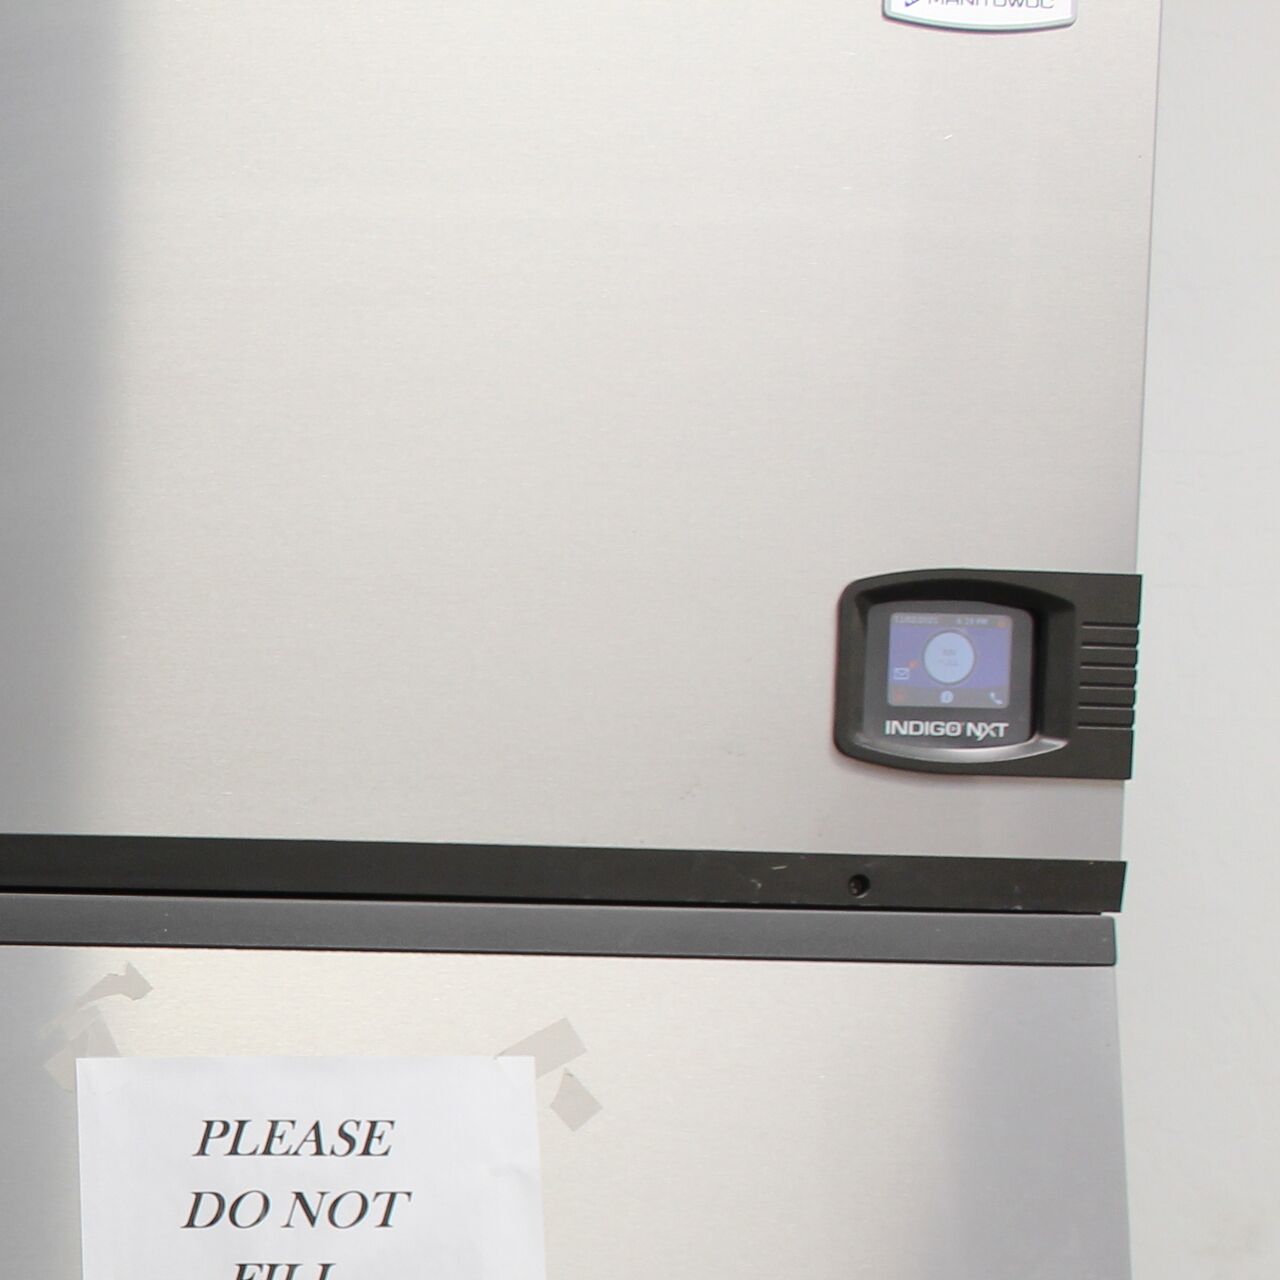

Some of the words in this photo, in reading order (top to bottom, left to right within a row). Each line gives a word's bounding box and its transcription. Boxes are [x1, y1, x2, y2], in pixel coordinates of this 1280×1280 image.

[885, 720, 962, 737] INDIGO
[966, 722, 1009, 741] NXT
[192, 1119, 396, 1157] PLEASE
[180, 1190, 270, 1229] DO
[281, 1190, 413, 1229] NOT
